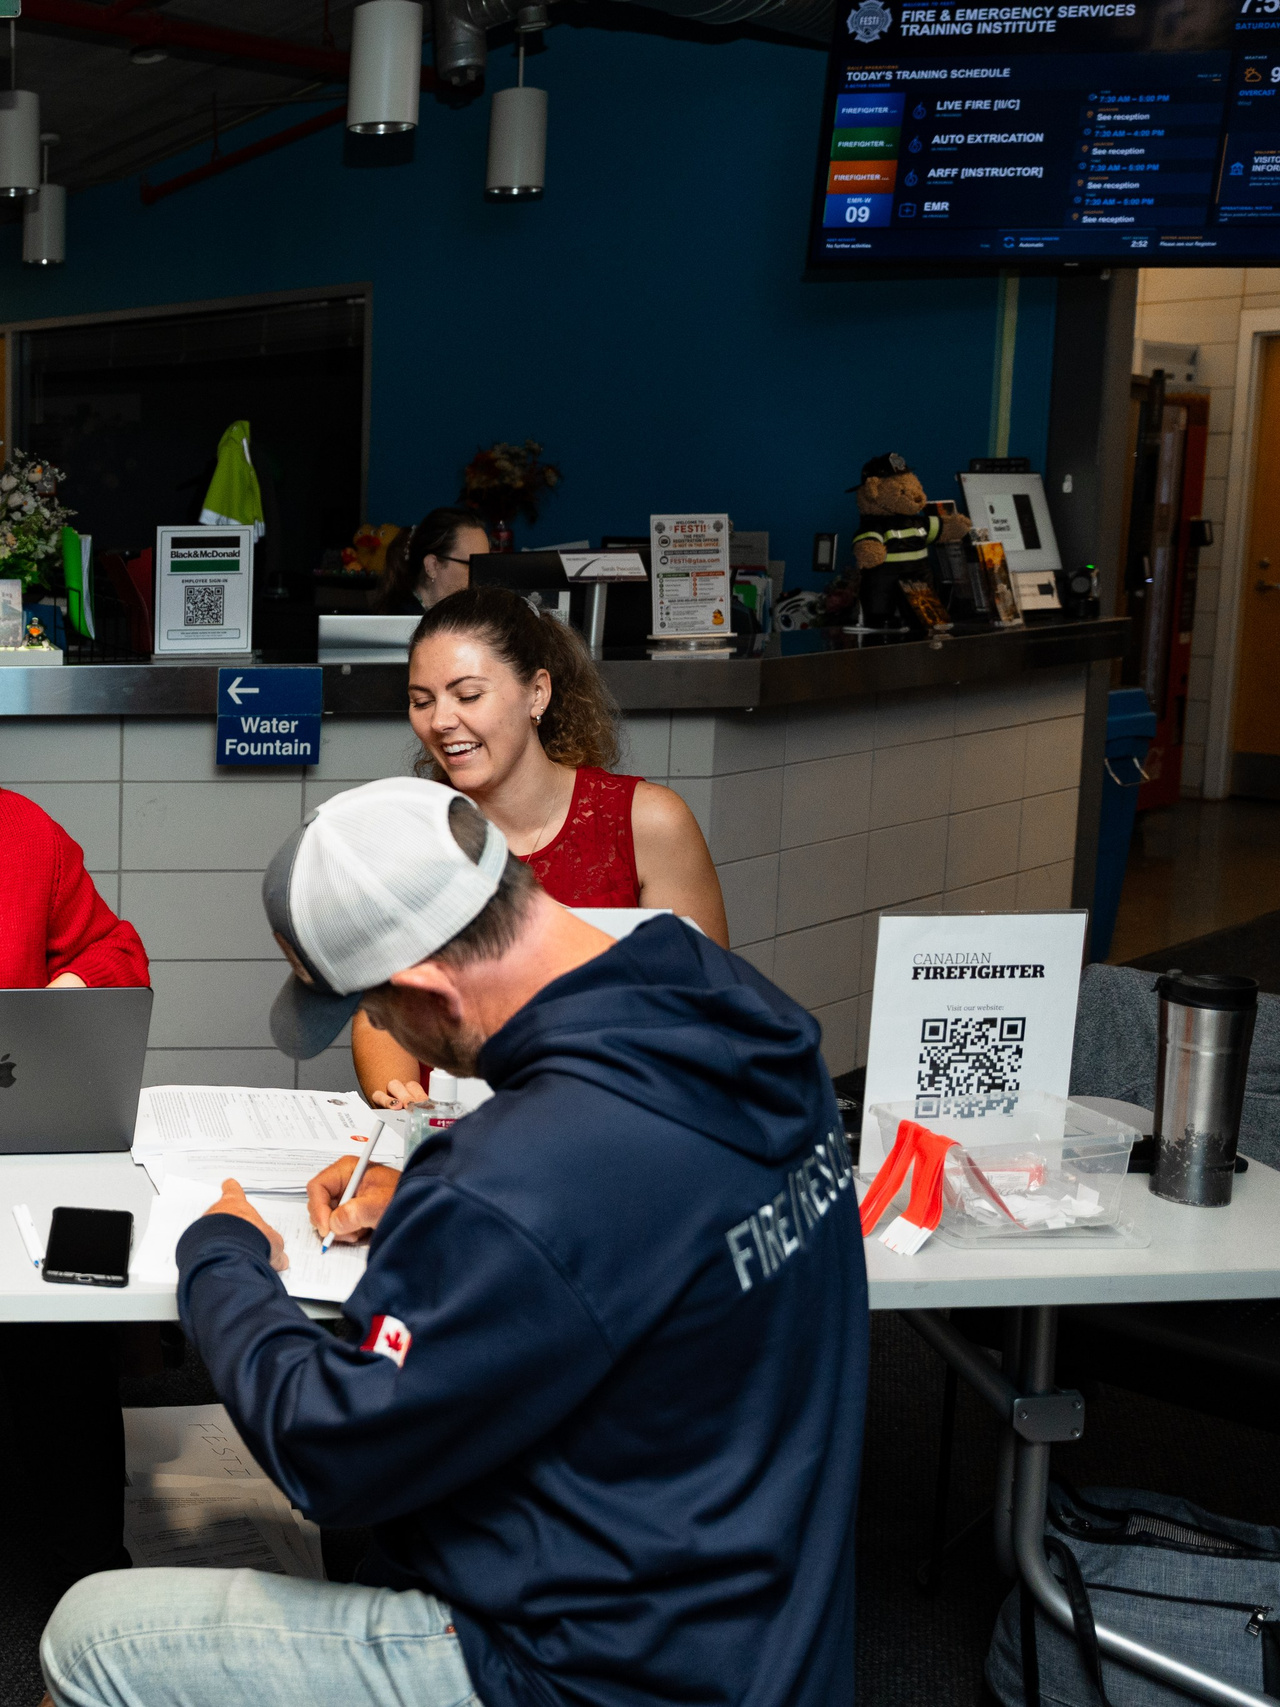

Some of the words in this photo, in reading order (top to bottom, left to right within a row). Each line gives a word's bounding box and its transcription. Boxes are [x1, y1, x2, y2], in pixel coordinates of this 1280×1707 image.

[901, 10, 935, 24] FIRE
[939, 10, 951, 21] &
[956, 7, 1053, 20] EMERGENCY
[1057, 4, 1136, 17] SERVICES
[859, 16, 880, 25] FESTI
[900, 22, 973, 37] TRAINING
[976, 20, 1056, 34] INSTITUTE
[846, 71, 893, 81] TODAY'S
[896, 70, 949, 80] TRAINING
[951, 68, 1011, 78] SCHEDULE
[1099, 95, 1117, 103] 7:30
[1117, 94, 1131, 103] AM
[1157, 94, 1170, 102] PM
[1238, 89, 1277, 97] OVERCAST
[936, 101, 962, 111] LIVE
[965, 100, 991, 110] FIRE
[1096, 113, 1109, 121] See
[1110, 112, 1150, 122] reception
[931, 135, 965, 145] AUTO
[967, 133, 1045, 144] EXTRICATION
[1094, 130, 1111, 138] 7:30
[1112, 129, 1126, 137] AM
[1152, 129, 1165, 137] PM
[1091, 147, 1104, 155] See
[1105, 147, 1145, 157] reception
[928, 169, 958, 179] ARFF
[960, 166, 1043, 180] [INSTRUCTOR]
[1089, 164, 1106, 172] 7:30
[1107, 163, 1121, 172] AM
[1147, 163, 1160, 171] PM
[1086, 182, 1099, 190] See
[1100, 181, 1140, 191] reception
[923, 201, 950, 212] EMR
[1084, 198, 1101, 206] 7:30
[1102, 198, 1116, 206] AM
[1141, 197, 1155, 206] PM
[845, 206, 870, 223] 09
[1081, 216, 1094, 224] See
[1095, 215, 1135, 225] reception
[1130, 239, 1149, 248] 2:52
[674, 524, 707, 533] FESTI!
[240, 717, 299, 734] Water
[225, 738, 312, 756] Fountain
[912, 952, 992, 964] CANADIAN
[912, 964, 1046, 980] FIREFIGHTER
[187, 1423, 251, 1476] FESTI
